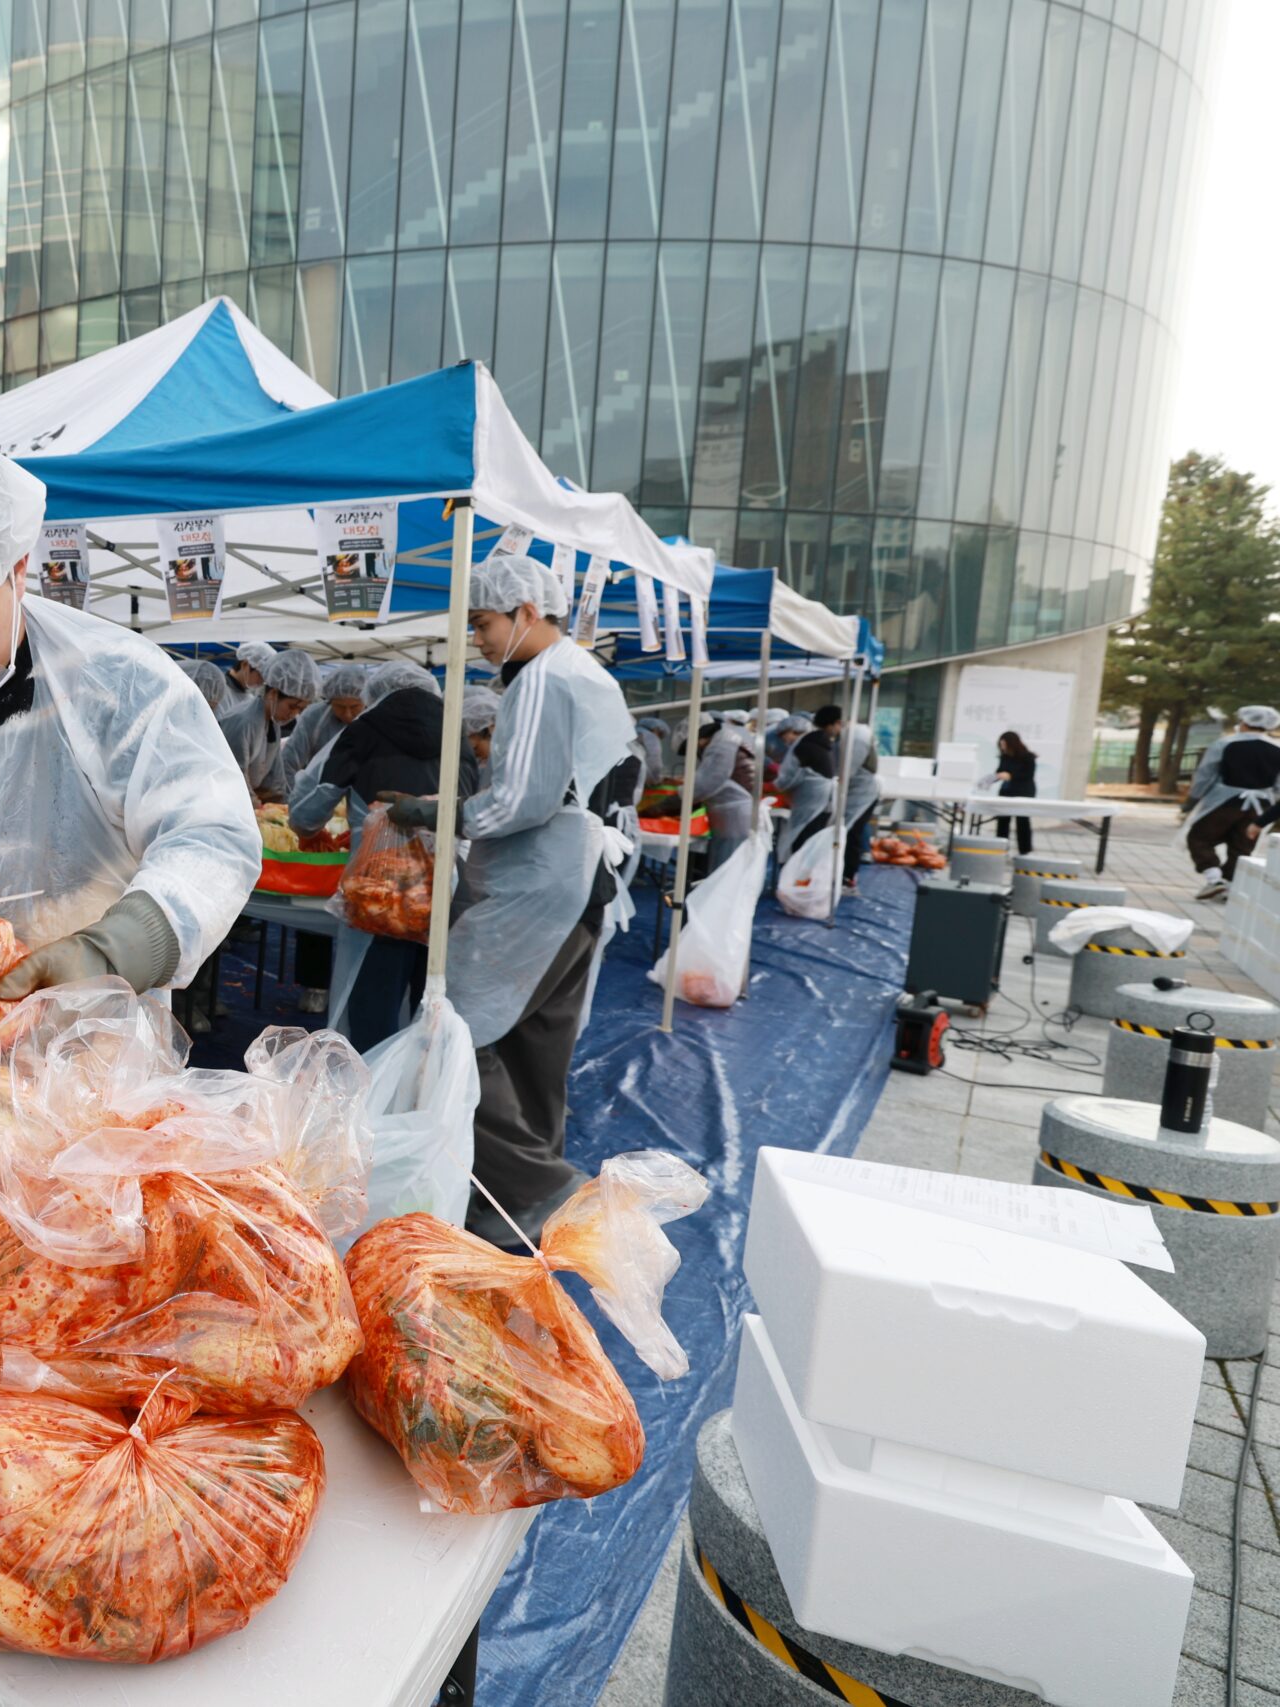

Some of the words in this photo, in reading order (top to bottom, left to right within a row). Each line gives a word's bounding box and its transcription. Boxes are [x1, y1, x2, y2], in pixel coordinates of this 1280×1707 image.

[335, 511, 383, 524] 김장봉사
[173, 519, 214, 532] 김장봉사
[343, 525, 380, 536] 대모집
[181, 532, 212, 542] 대모집
